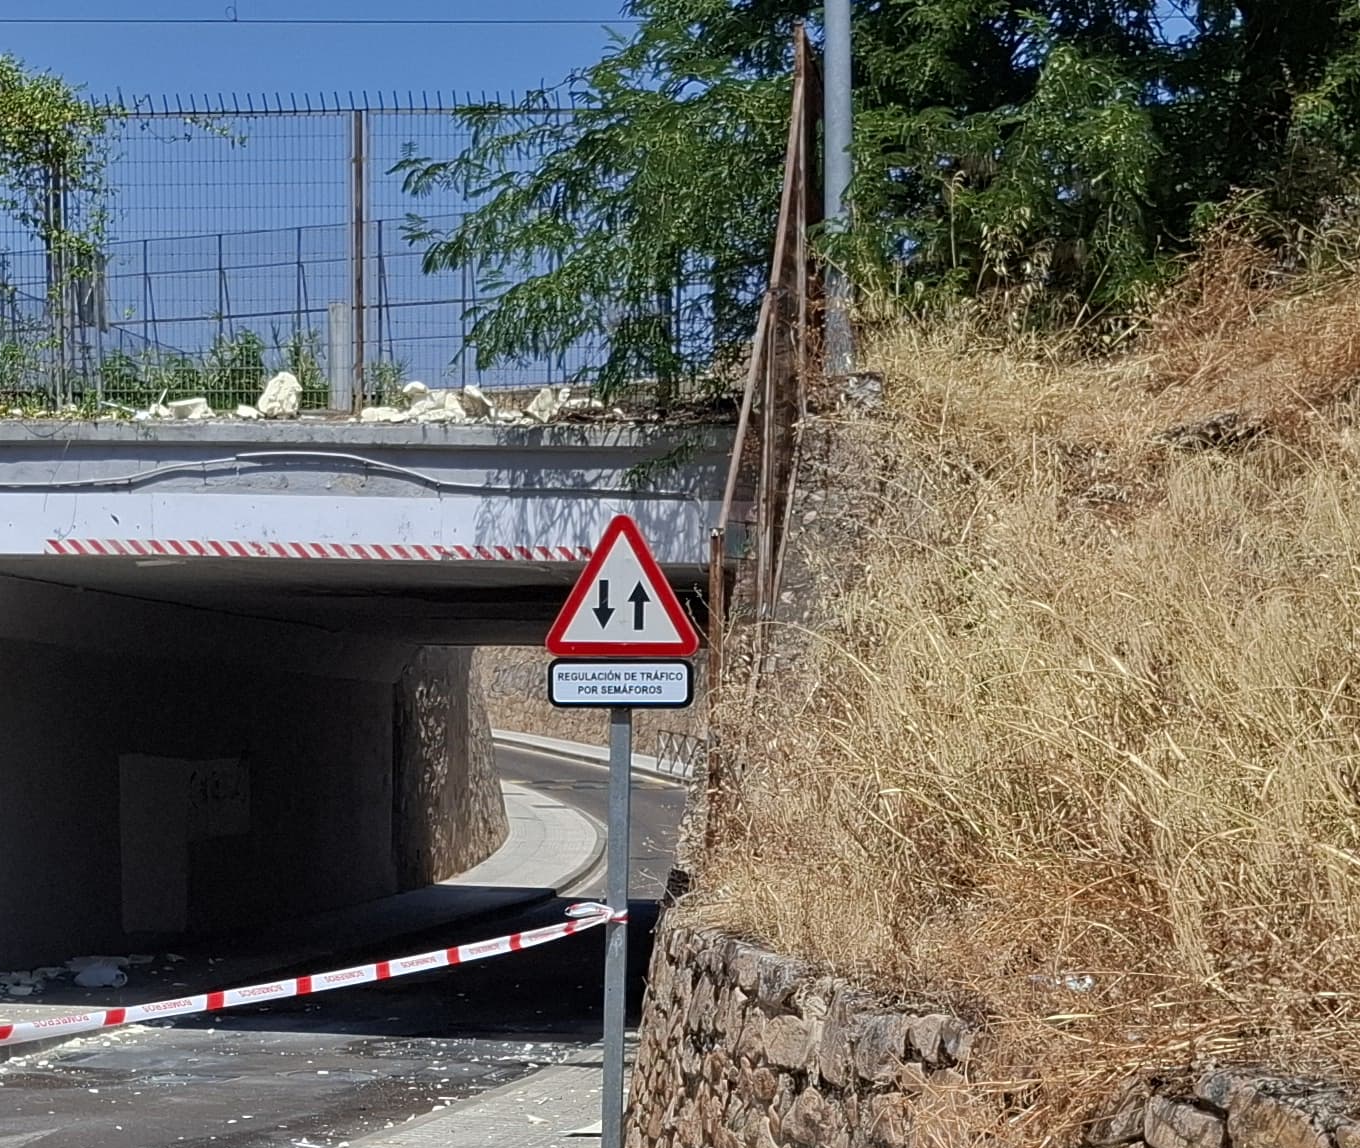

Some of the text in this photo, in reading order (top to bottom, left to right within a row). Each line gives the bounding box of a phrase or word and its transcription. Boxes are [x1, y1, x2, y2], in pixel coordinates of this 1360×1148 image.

[557, 670, 683, 681] REGULACIÓN DE TRÁFICO
[577, 684, 663, 695] POR SEMÁFOROS
